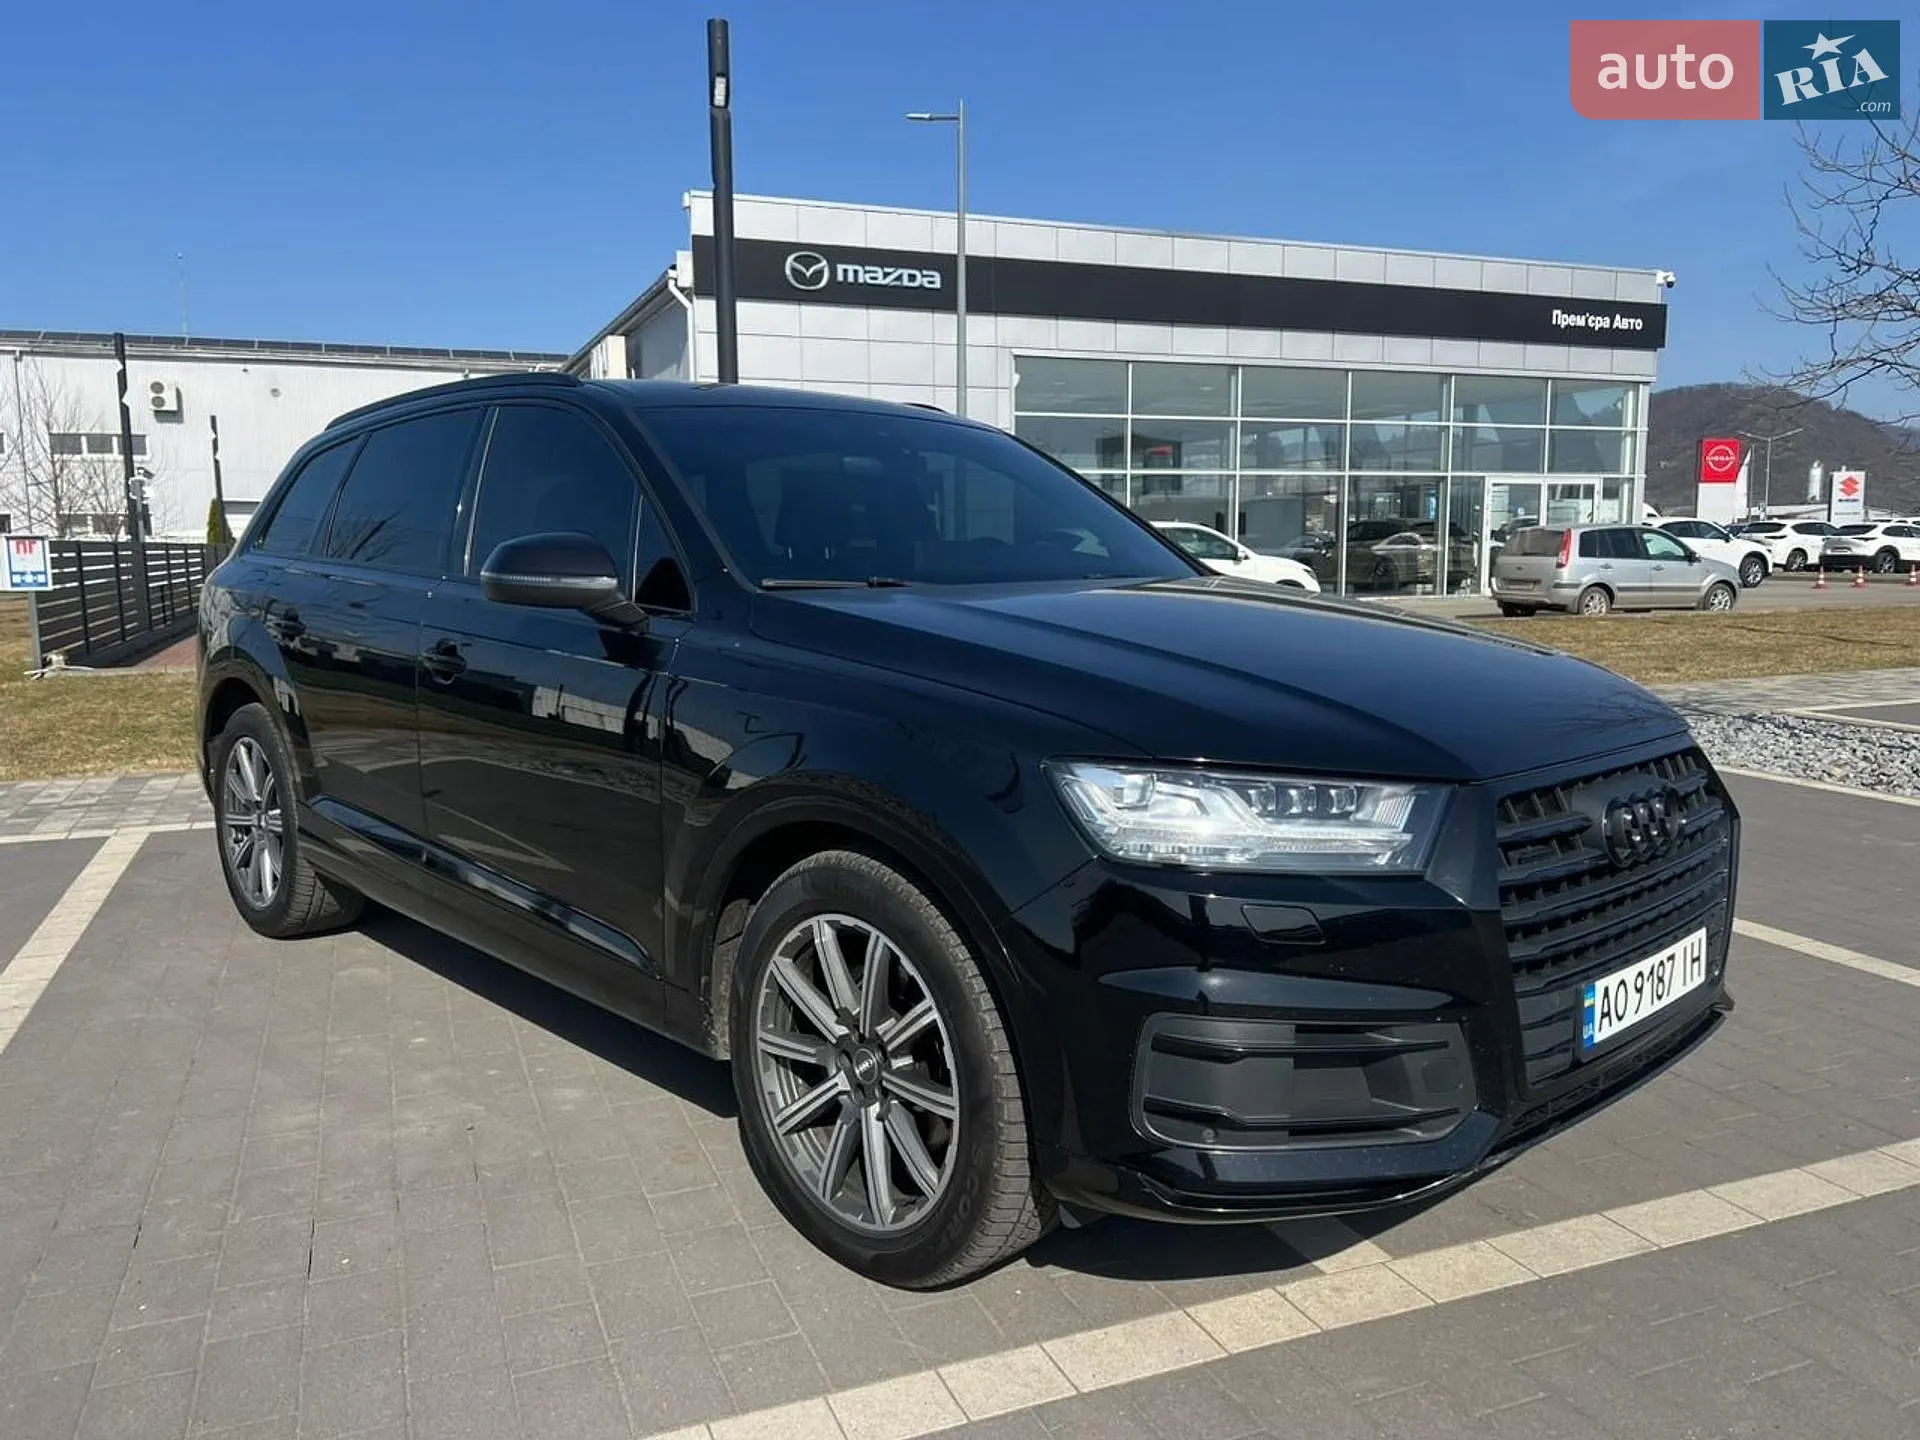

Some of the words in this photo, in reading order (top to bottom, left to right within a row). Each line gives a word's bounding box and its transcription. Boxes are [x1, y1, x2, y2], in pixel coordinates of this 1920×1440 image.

[836, 263, 942, 290] mazda
[1612, 313, 1644, 330] Авто
[1597, 977, 1629, 1033] AO
[1633, 952, 1677, 1015] 9187
[1682, 937, 1703, 987] IH
